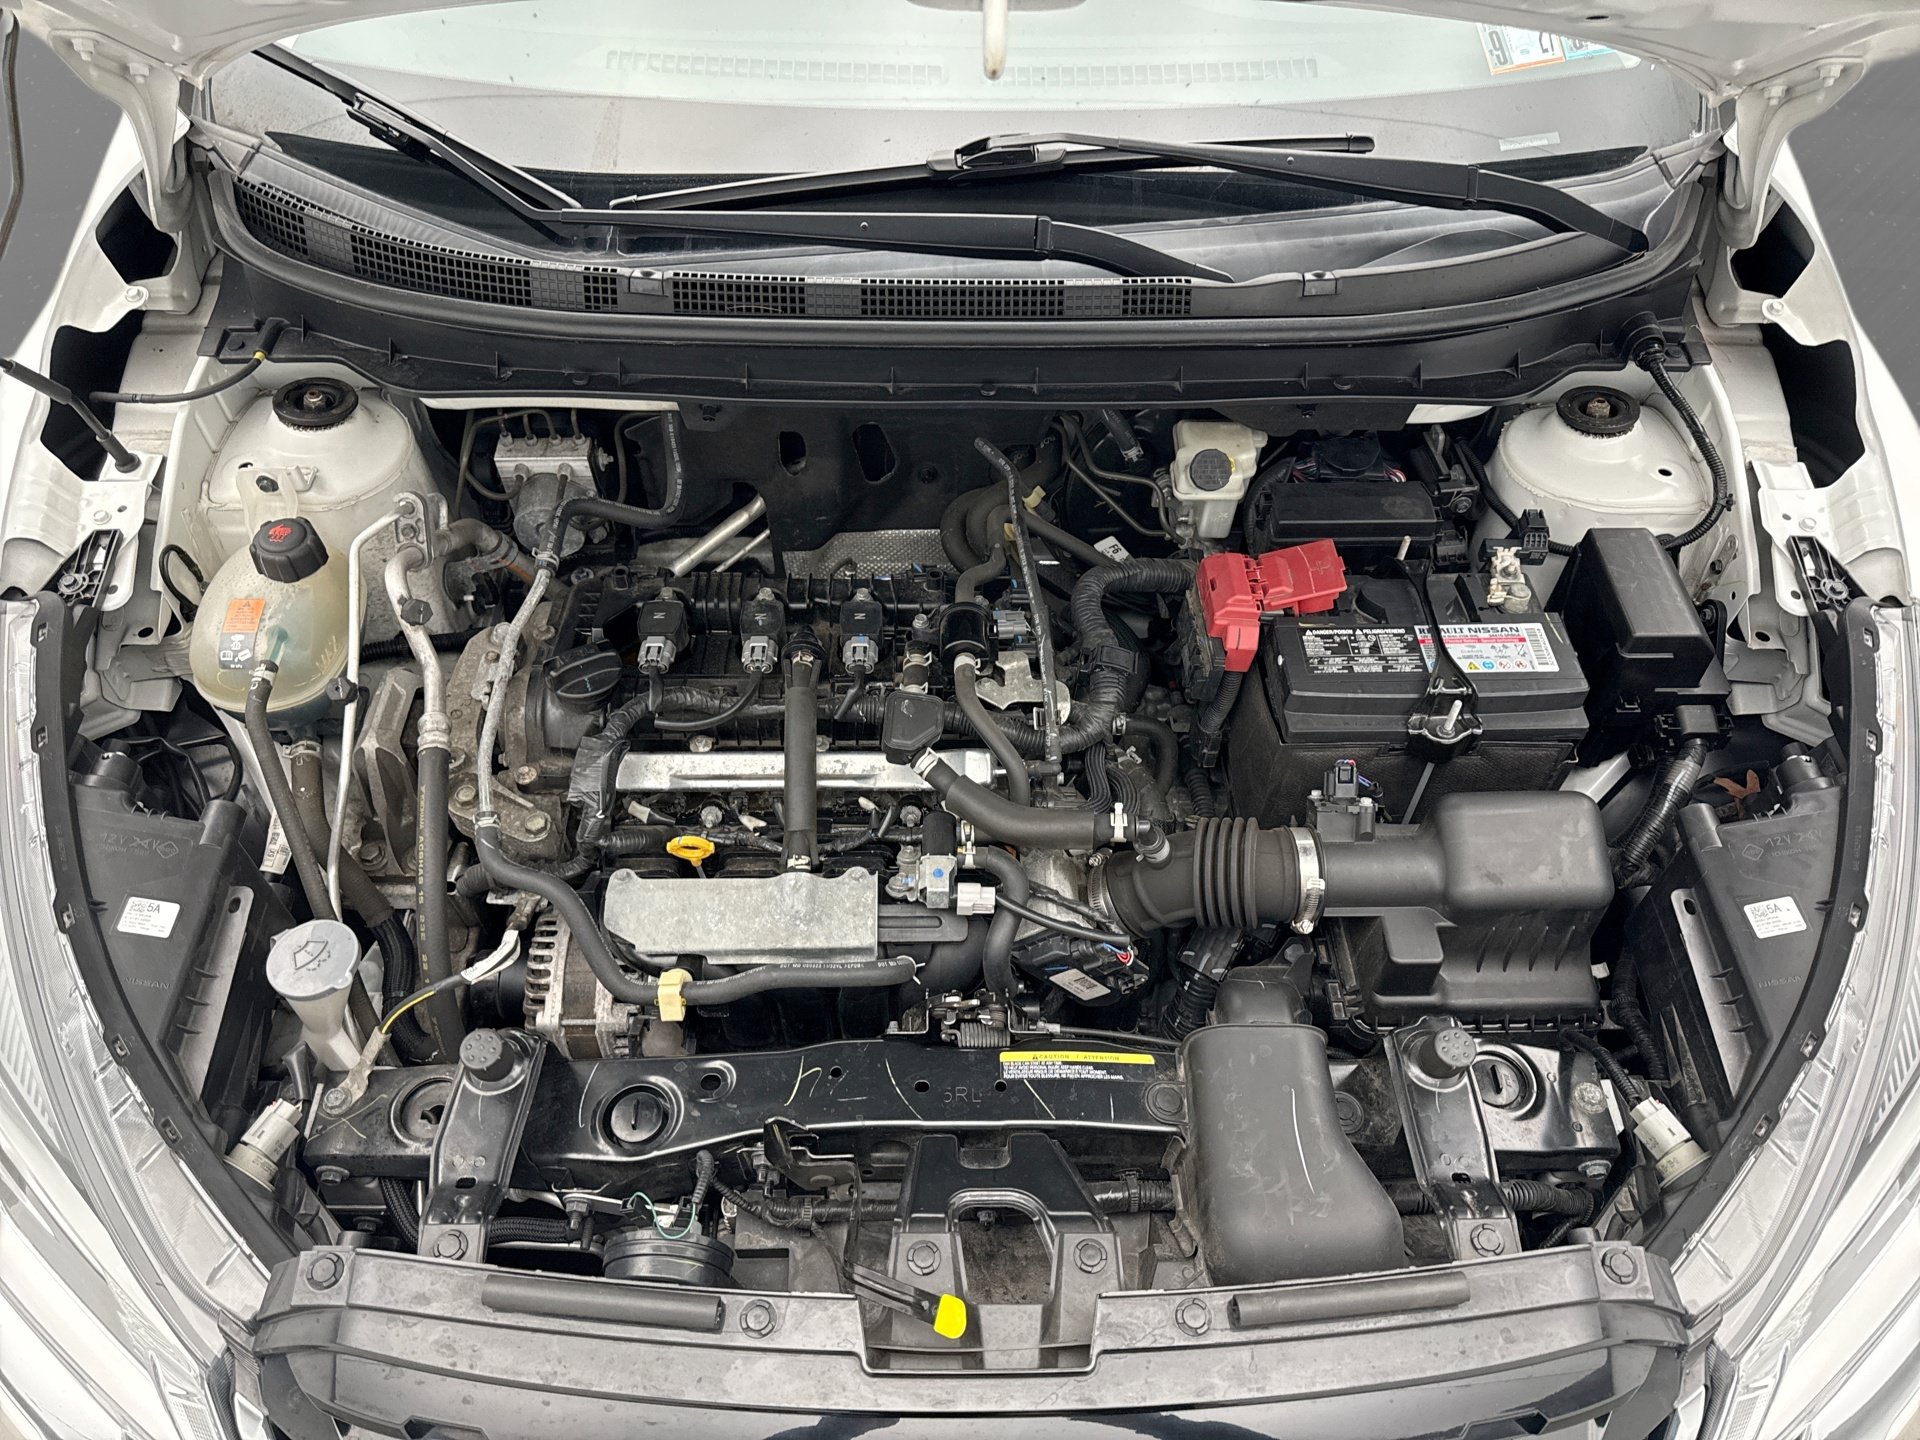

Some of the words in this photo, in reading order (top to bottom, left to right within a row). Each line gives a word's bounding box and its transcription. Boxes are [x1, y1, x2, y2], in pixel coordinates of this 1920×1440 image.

[1108, 543, 1122, 555] F6
[418, 890, 424, 905] 15
[146, 902, 161, 915] 5A
[1766, 903, 1782, 914] 5A
[124, 977, 171, 990] NISSAN
[1758, 975, 1803, 989] NISSAN
